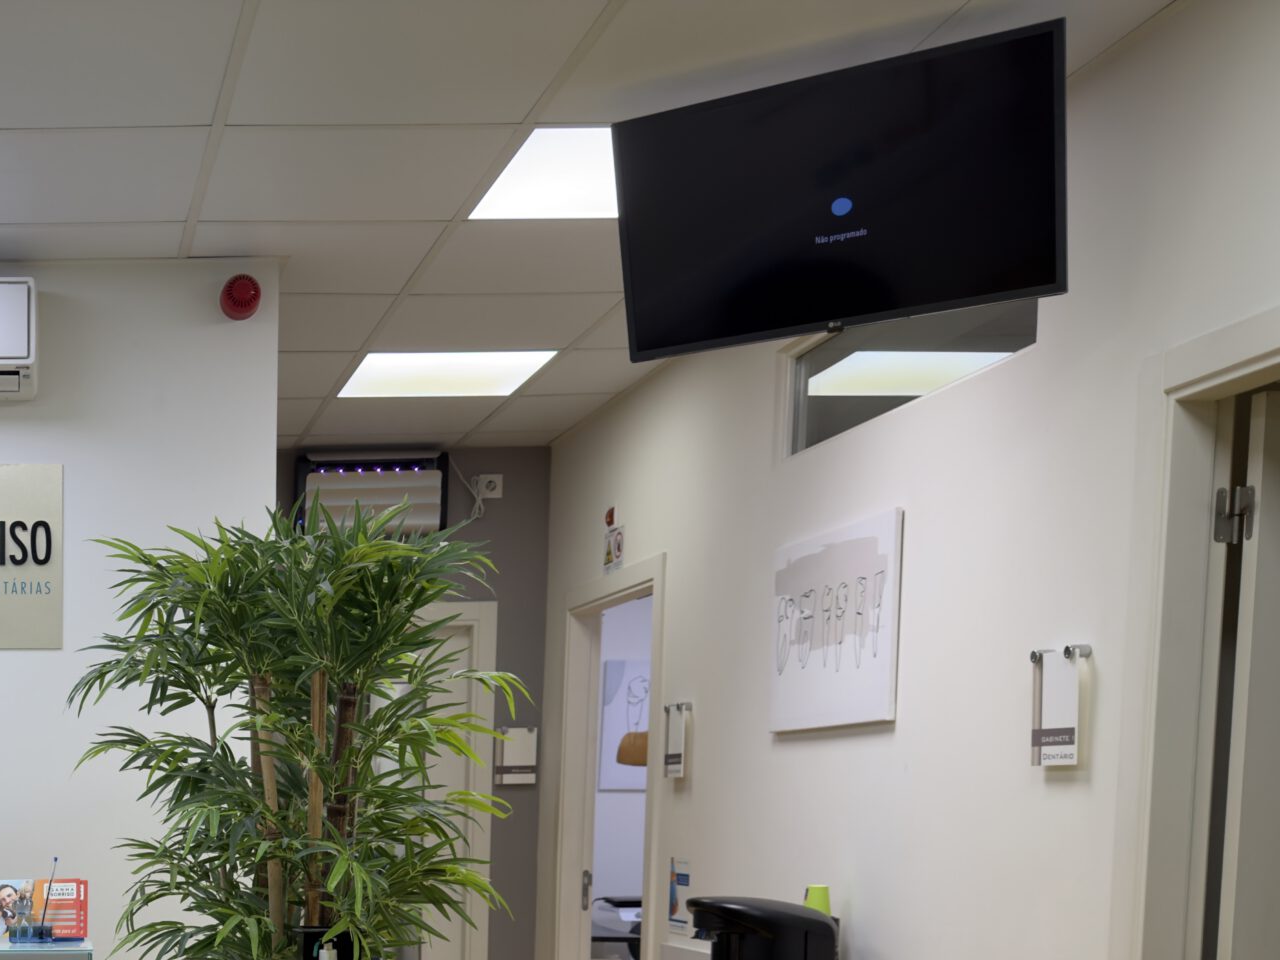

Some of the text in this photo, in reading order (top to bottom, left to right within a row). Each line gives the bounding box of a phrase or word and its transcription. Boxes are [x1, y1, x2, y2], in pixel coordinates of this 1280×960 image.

[815, 228, 868, 245] Não programado
[1042, 752, 1075, 761] DENTÁRIO
